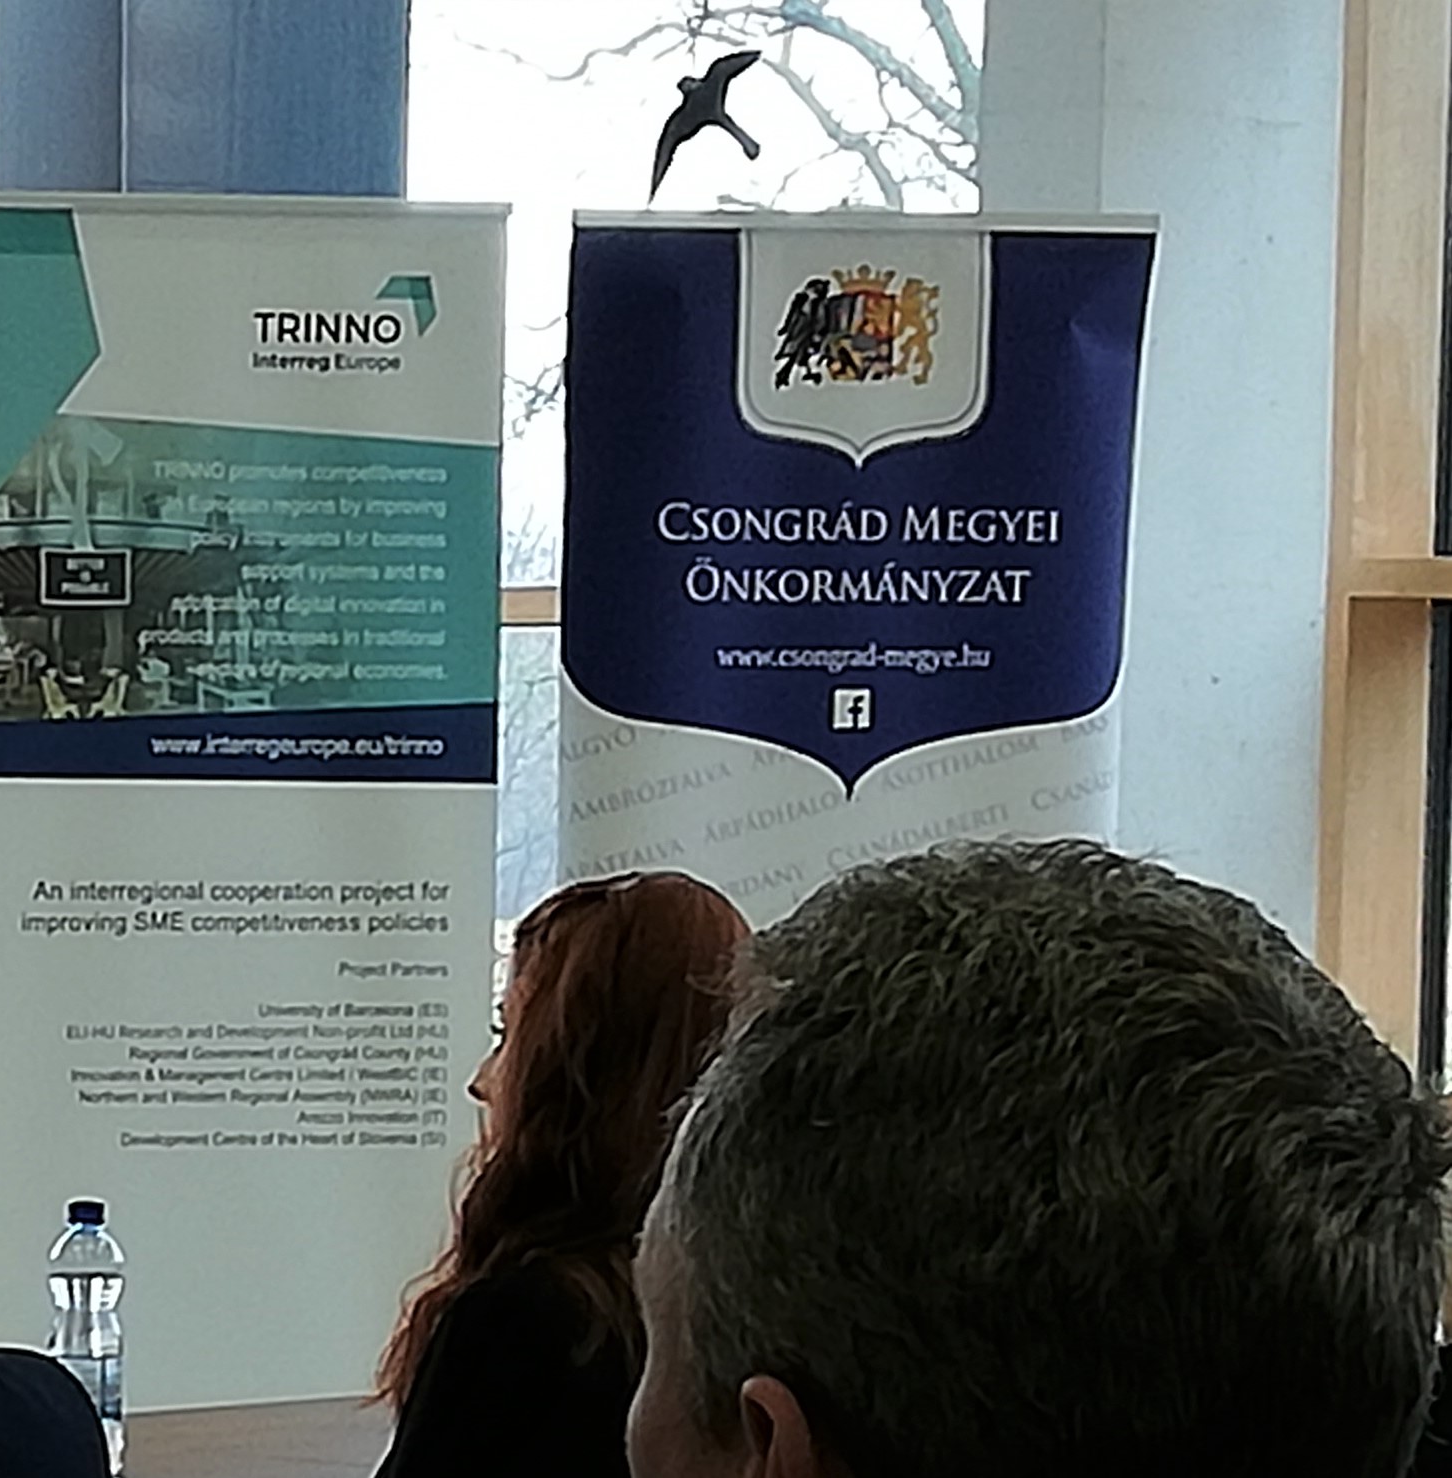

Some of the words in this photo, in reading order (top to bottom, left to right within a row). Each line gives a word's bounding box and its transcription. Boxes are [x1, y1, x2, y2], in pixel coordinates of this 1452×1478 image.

[253, 312, 401, 344] TRINNO
[252, 352, 330, 373] Interreg
[334, 352, 401, 374] Europe
[339, 497, 362, 518] by
[365, 498, 446, 519] improving
[657, 500, 889, 543] CSONGRÁD
[902, 504, 1060, 544] MEGYEI
[345, 529, 368, 547] for
[383, 563, 415, 582] and
[685, 556, 1033, 603] ÖNKORMÁNYZAT
[430, 597, 445, 614] in
[343, 628, 359, 646] in
[716, 642, 991, 674] www.csongrad-megye.hu
[150, 733, 444, 760] www.interregeurope.eu/trinno
[32, 880, 64, 901] An
[69, 880, 204, 906] interregional
[209, 881, 334, 906] cooperation
[340, 880, 415, 908] project
[421, 881, 450, 901] for
[20, 910, 127, 938] improving
[133, 910, 185, 933] SME
[190, 912, 361, 935] competitiveness
[368, 910, 450, 936] policies
[338, 961, 388, 979] Project
[391, 961, 449, 977] Partners
[326, 1003, 341, 1017] of
[186, 1024, 213, 1039] and
[276, 1046, 291, 1060] of
